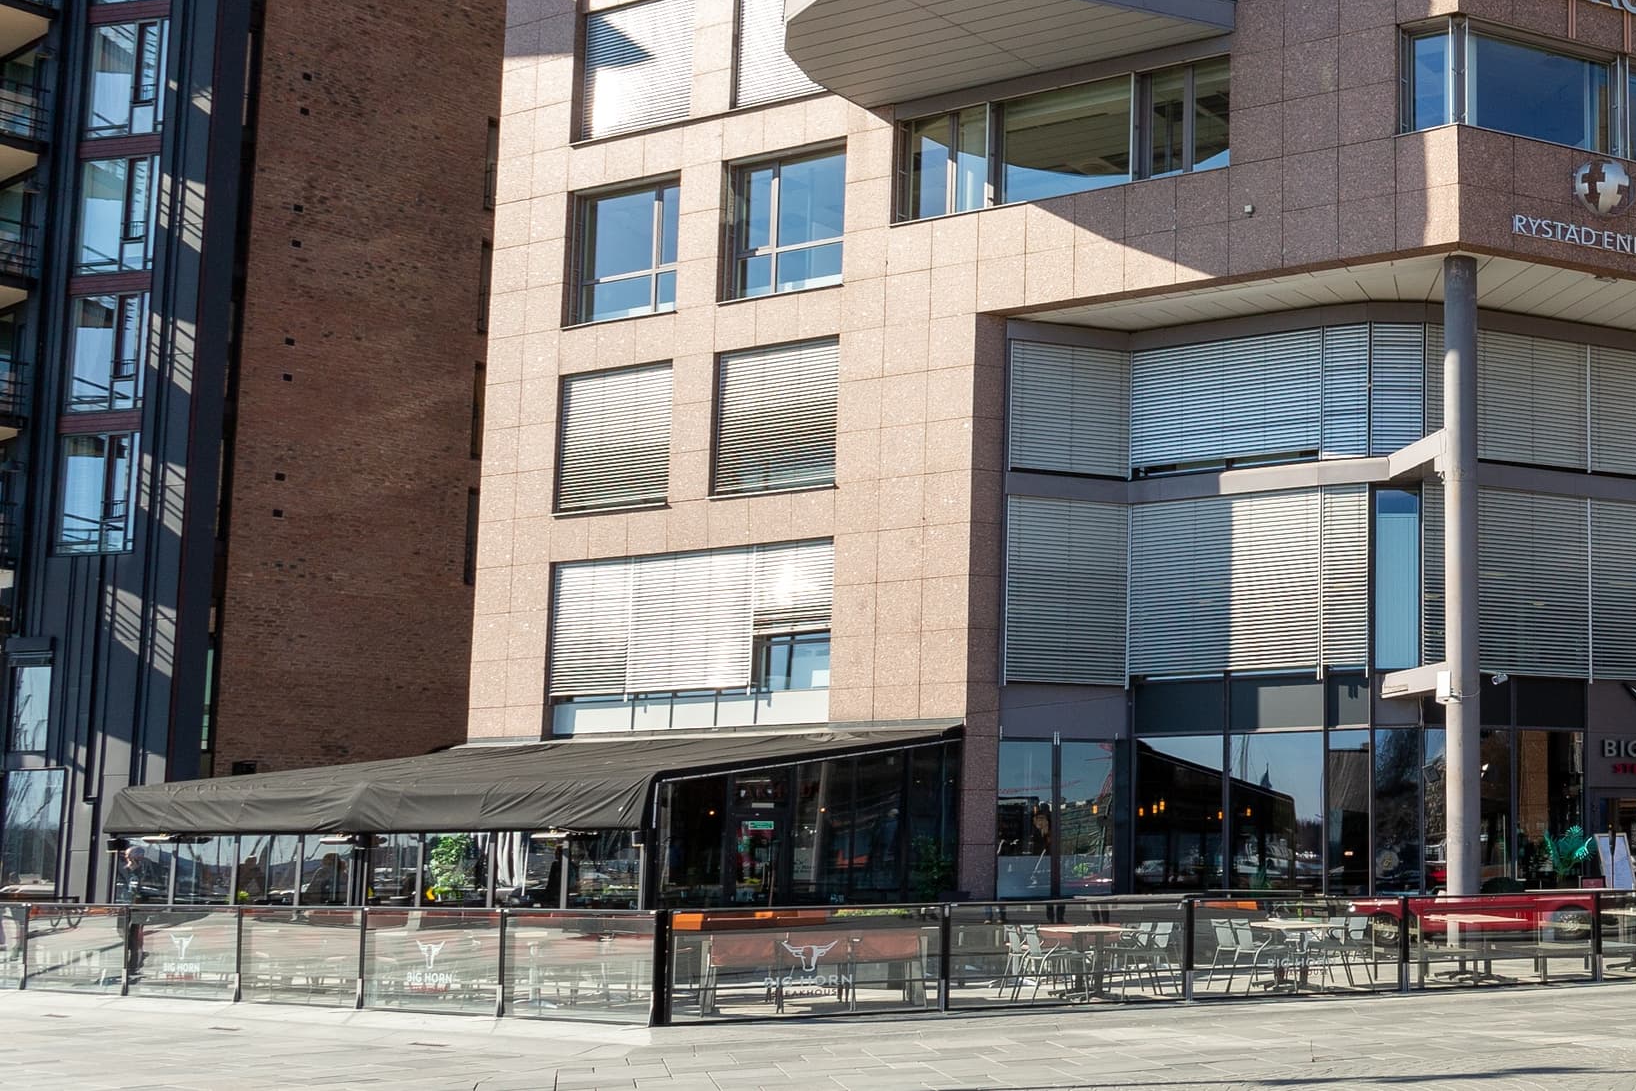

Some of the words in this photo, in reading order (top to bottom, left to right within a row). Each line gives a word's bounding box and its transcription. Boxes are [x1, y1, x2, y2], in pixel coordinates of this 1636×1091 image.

[1513, 213, 1596, 246] RYSTAD
[407, 971, 422, 983] BIG
[424, 972, 454, 984] HORN
[764, 976, 793, 988] BIG
[800, 973, 854, 987] HORN
